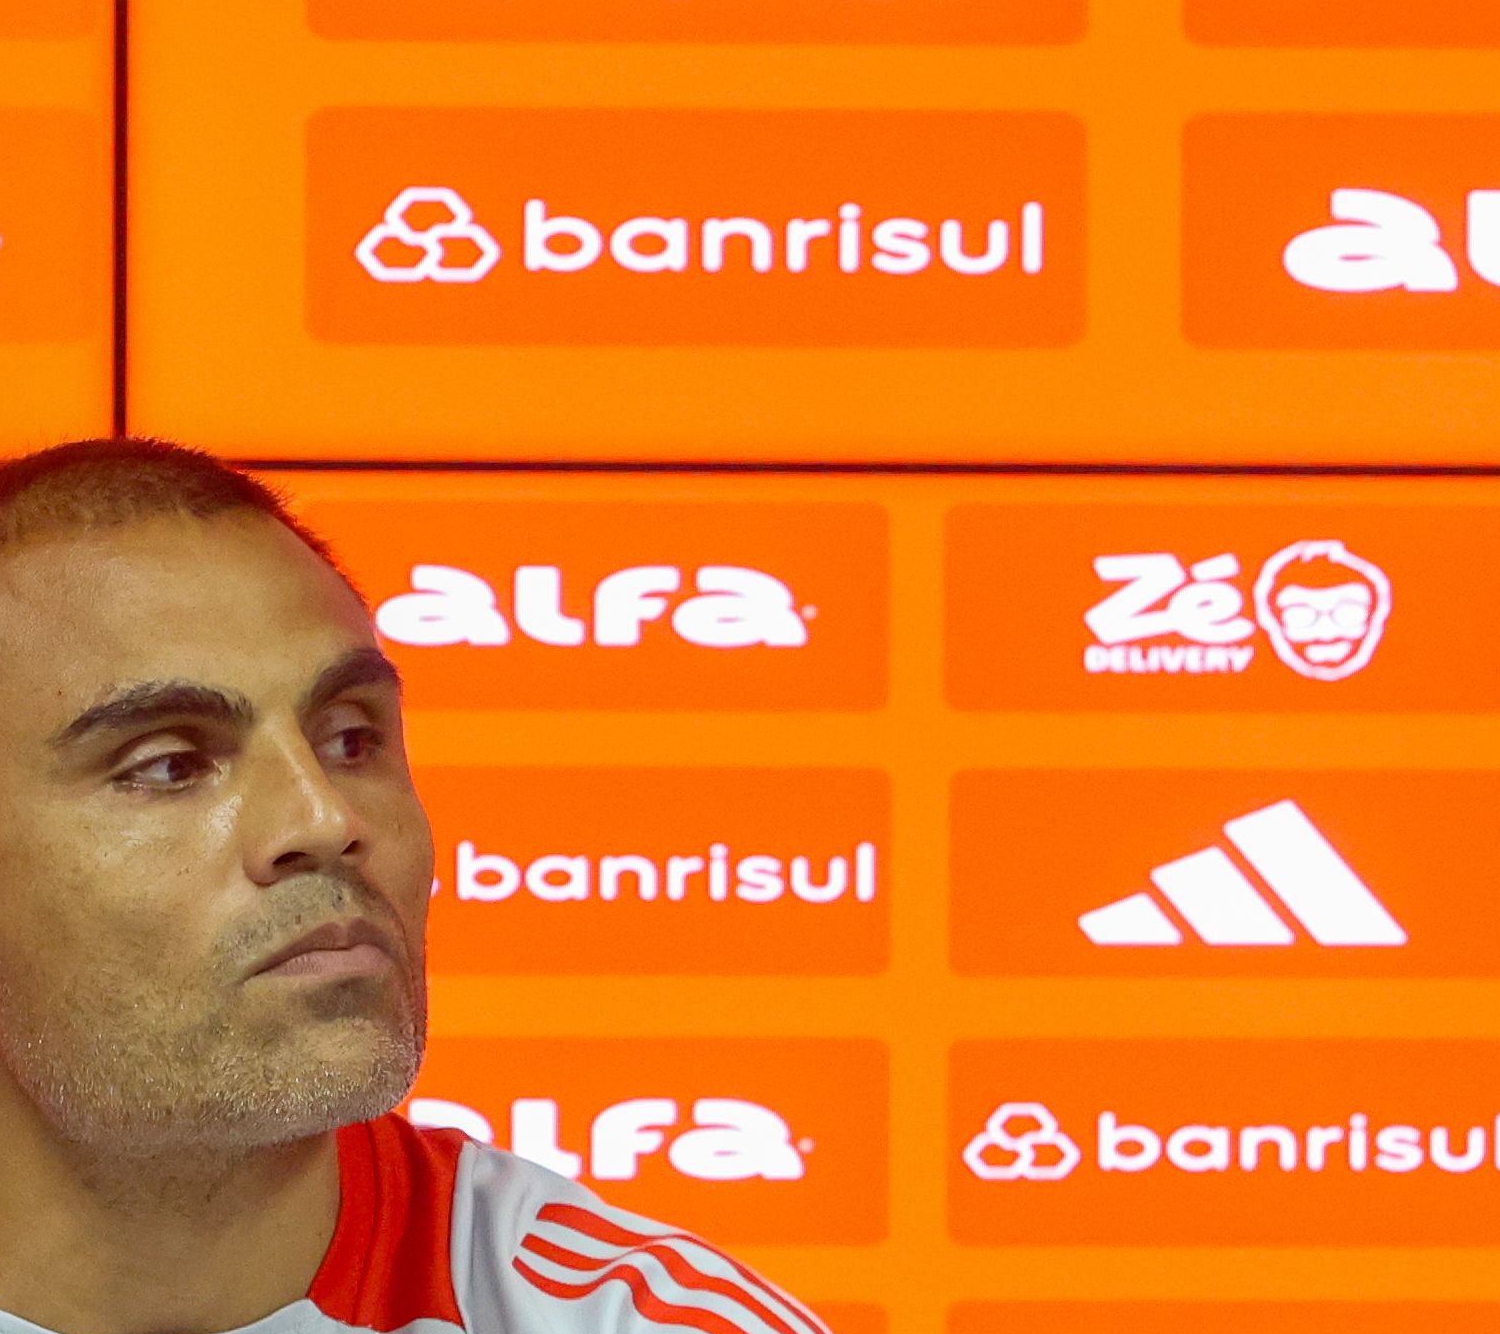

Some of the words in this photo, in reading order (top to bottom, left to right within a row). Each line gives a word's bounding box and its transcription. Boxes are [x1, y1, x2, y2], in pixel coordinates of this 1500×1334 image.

[524, 199, 1043, 274] banrisul
[376, 565, 815, 648] alfa
[1084, 553, 1255, 644] Zé
[1084, 645, 1254, 673] DELIVERY
[457, 841, 876, 902] banrisul
